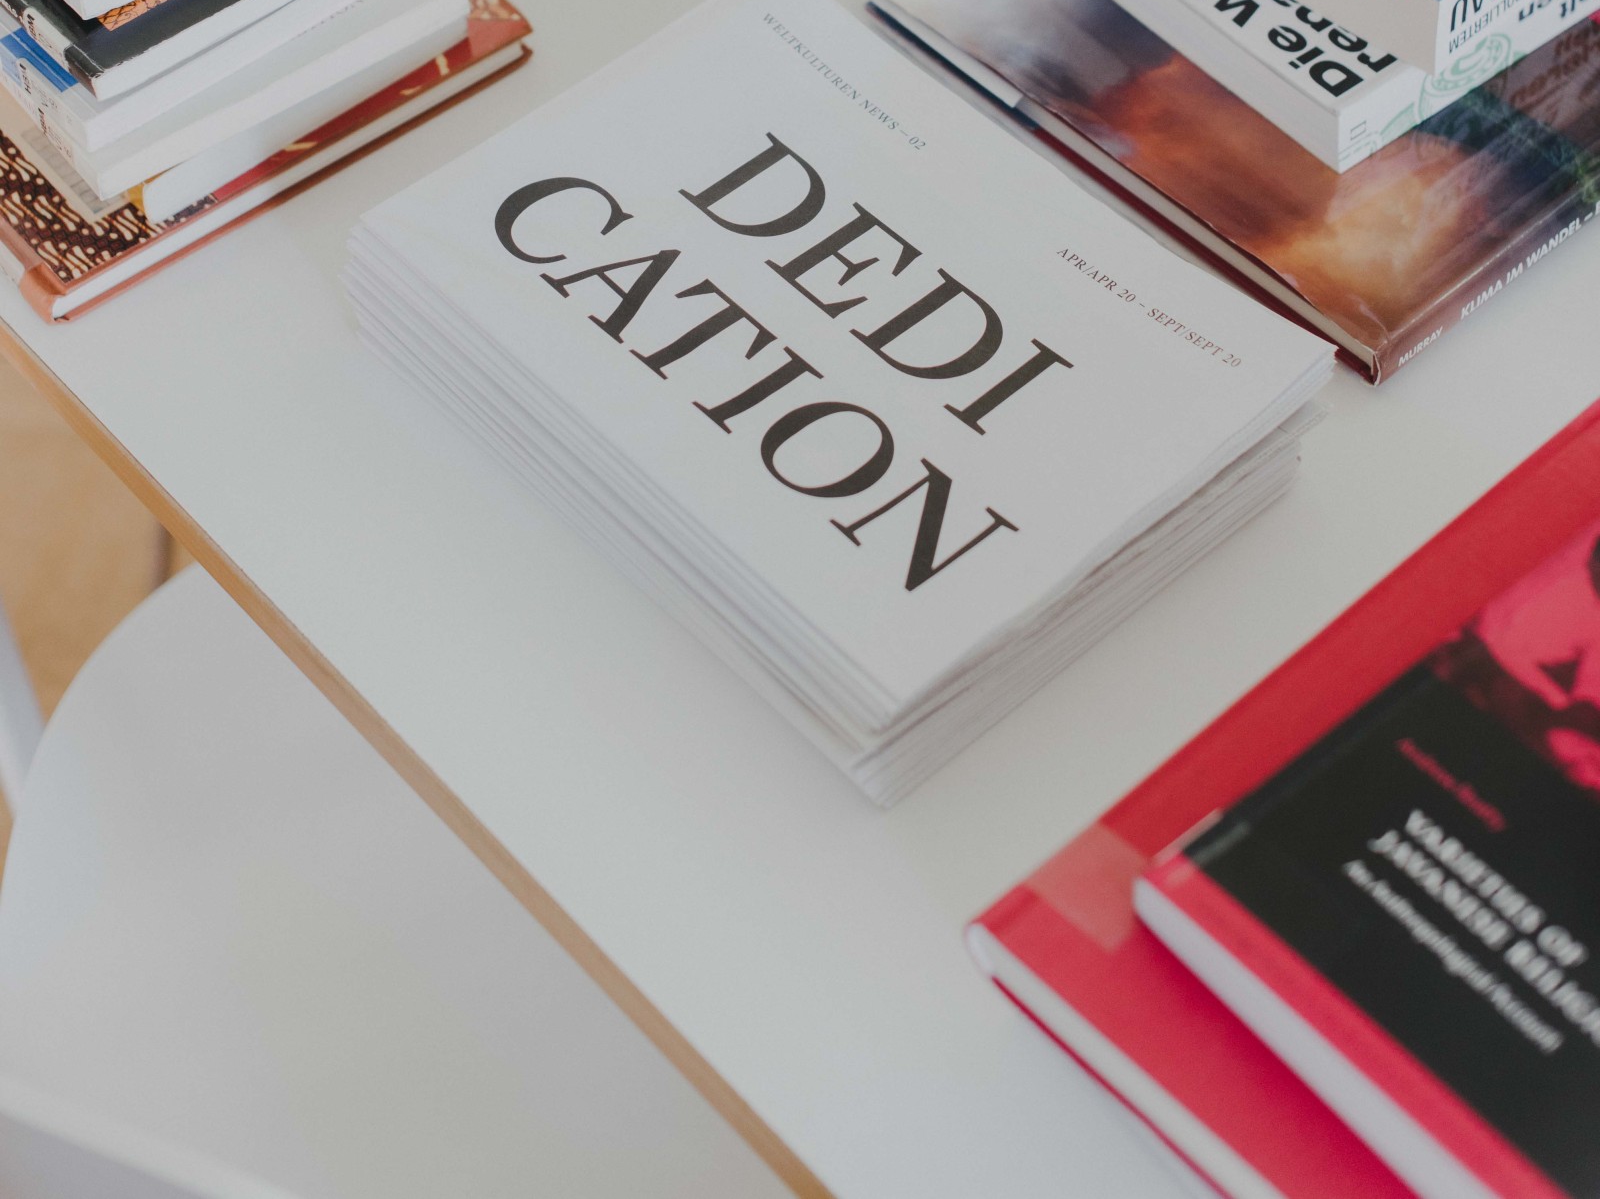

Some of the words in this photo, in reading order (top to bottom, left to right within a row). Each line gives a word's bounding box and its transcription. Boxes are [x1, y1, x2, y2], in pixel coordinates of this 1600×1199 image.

[763, 13, 862, 100] WELTKULTUREN
[858, 99, 900, 131] NEWS
[908, 135, 927, 151] 02
[1267, 24, 1364, 98] Die
[677, 131, 1075, 436] DEDI
[1056, 247, 1119, 292] APR/APR
[1116, 288, 1137, 303] 20
[1147, 307, 1224, 357] SEPT/SEPT
[1221, 353, 1242, 369] 20
[1398, 326, 1444, 367] MURRAY
[1460, 280, 1503, 320] KLIMA
[1506, 263, 1524, 285] IM
[1526, 217, 1582, 268] WANDEL
[493, 176, 1020, 593] CATION
